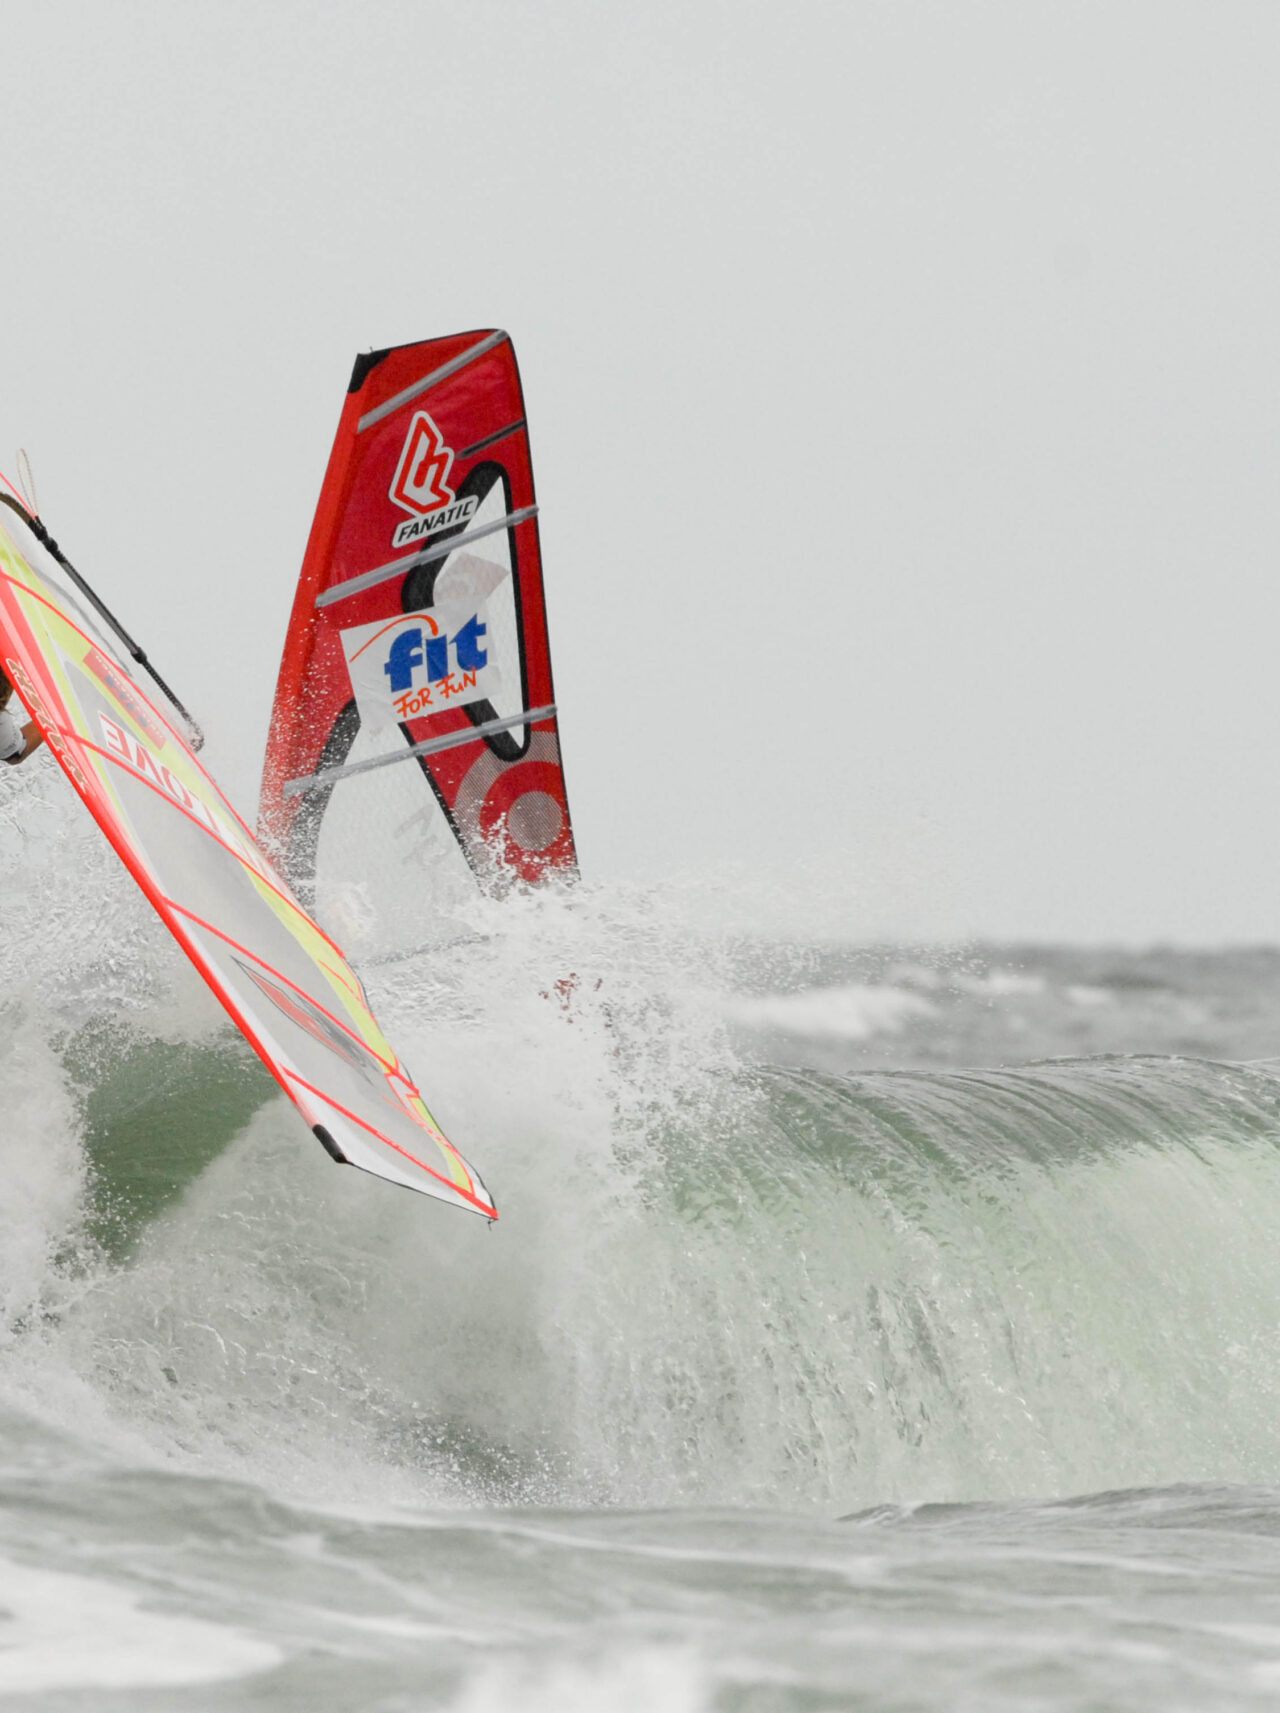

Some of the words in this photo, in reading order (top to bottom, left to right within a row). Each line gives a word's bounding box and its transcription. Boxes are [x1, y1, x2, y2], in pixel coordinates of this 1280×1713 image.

[398, 500, 473, 542] FANATIC
[384, 613, 487, 693] fit
[5, 657, 93, 795] NAISH
[393, 687, 434, 718] FOR
